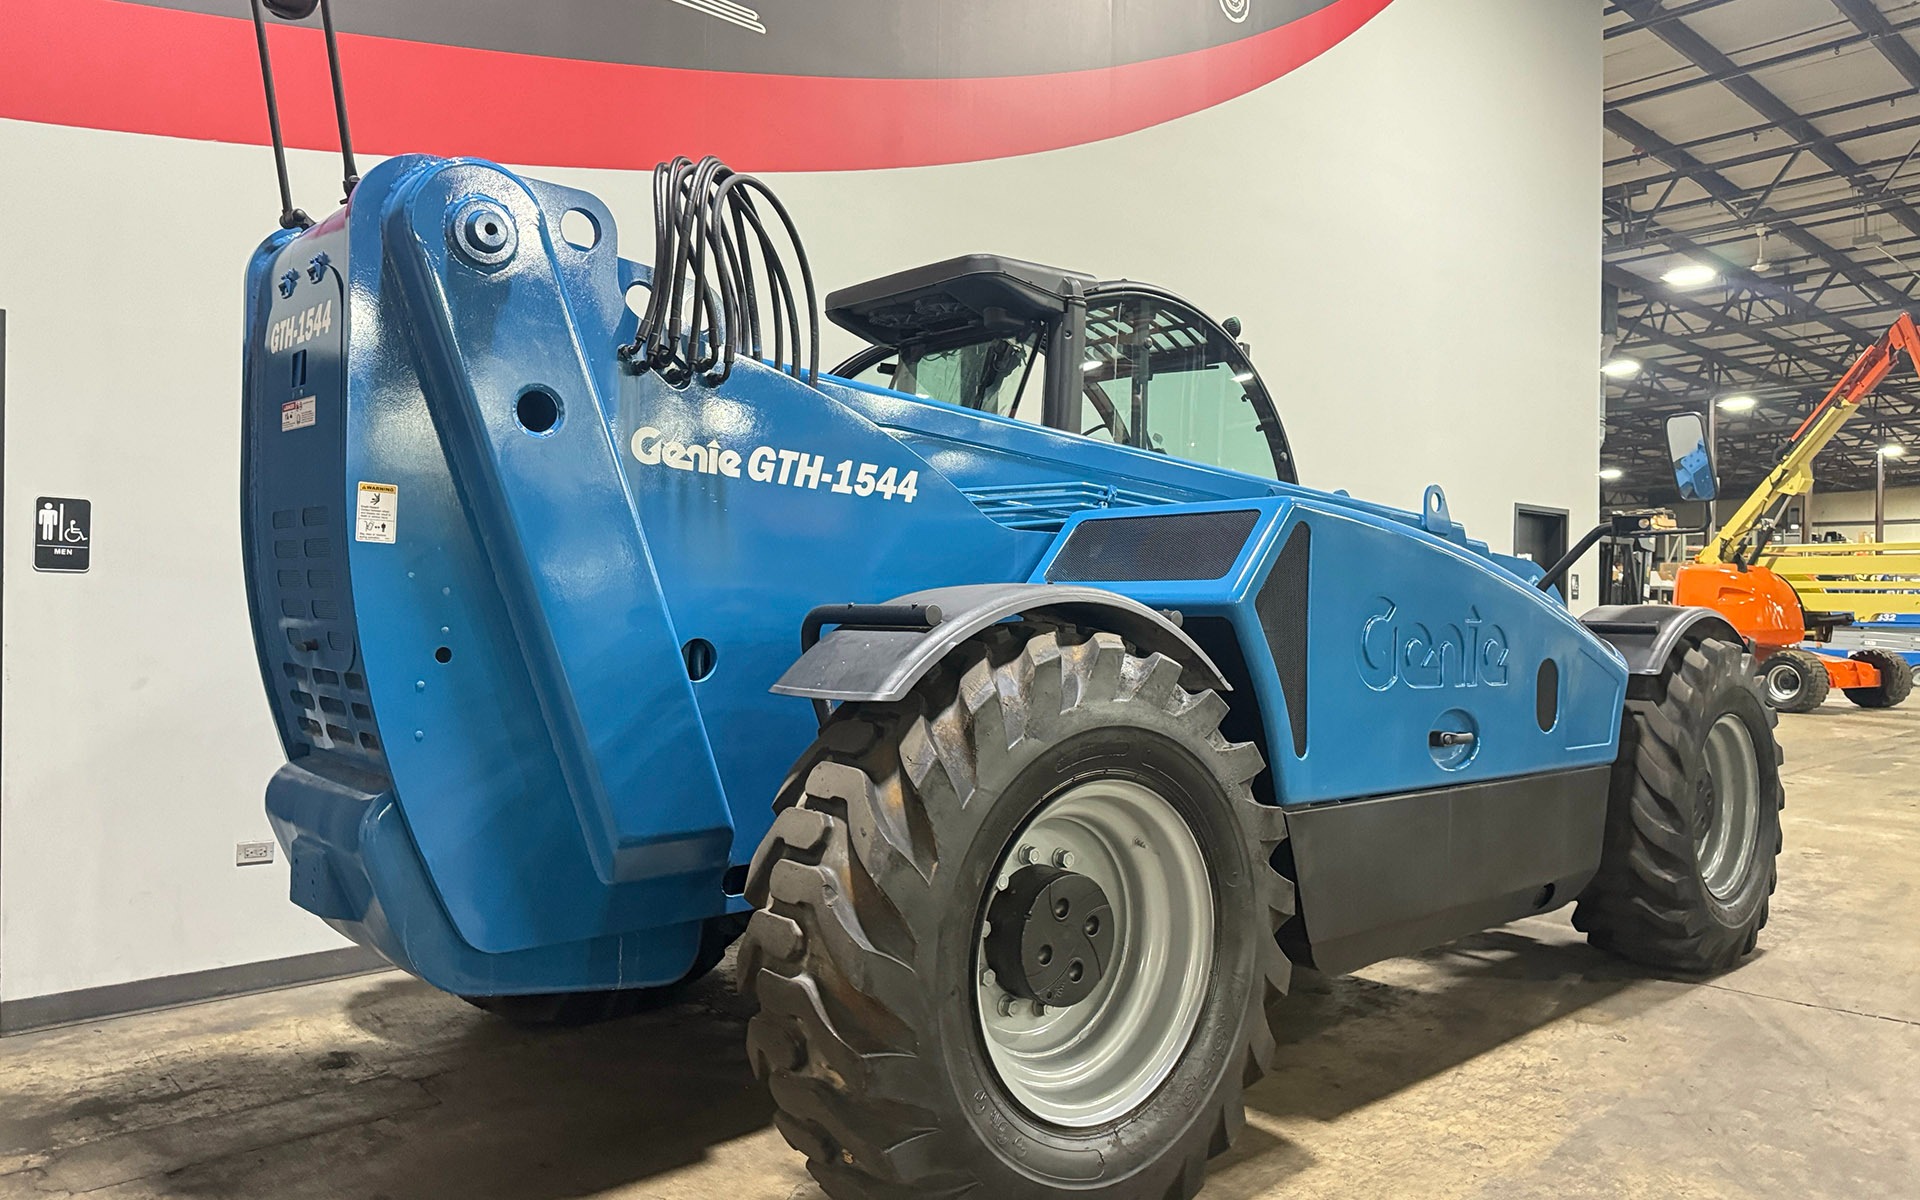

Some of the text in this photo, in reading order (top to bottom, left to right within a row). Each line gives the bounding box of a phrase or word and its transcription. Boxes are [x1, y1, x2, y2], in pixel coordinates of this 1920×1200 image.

[270, 300, 332, 354] GTH-1544
[631, 427, 919, 503] Genie GTH-1544
[1356, 595, 1509, 692] Genie
